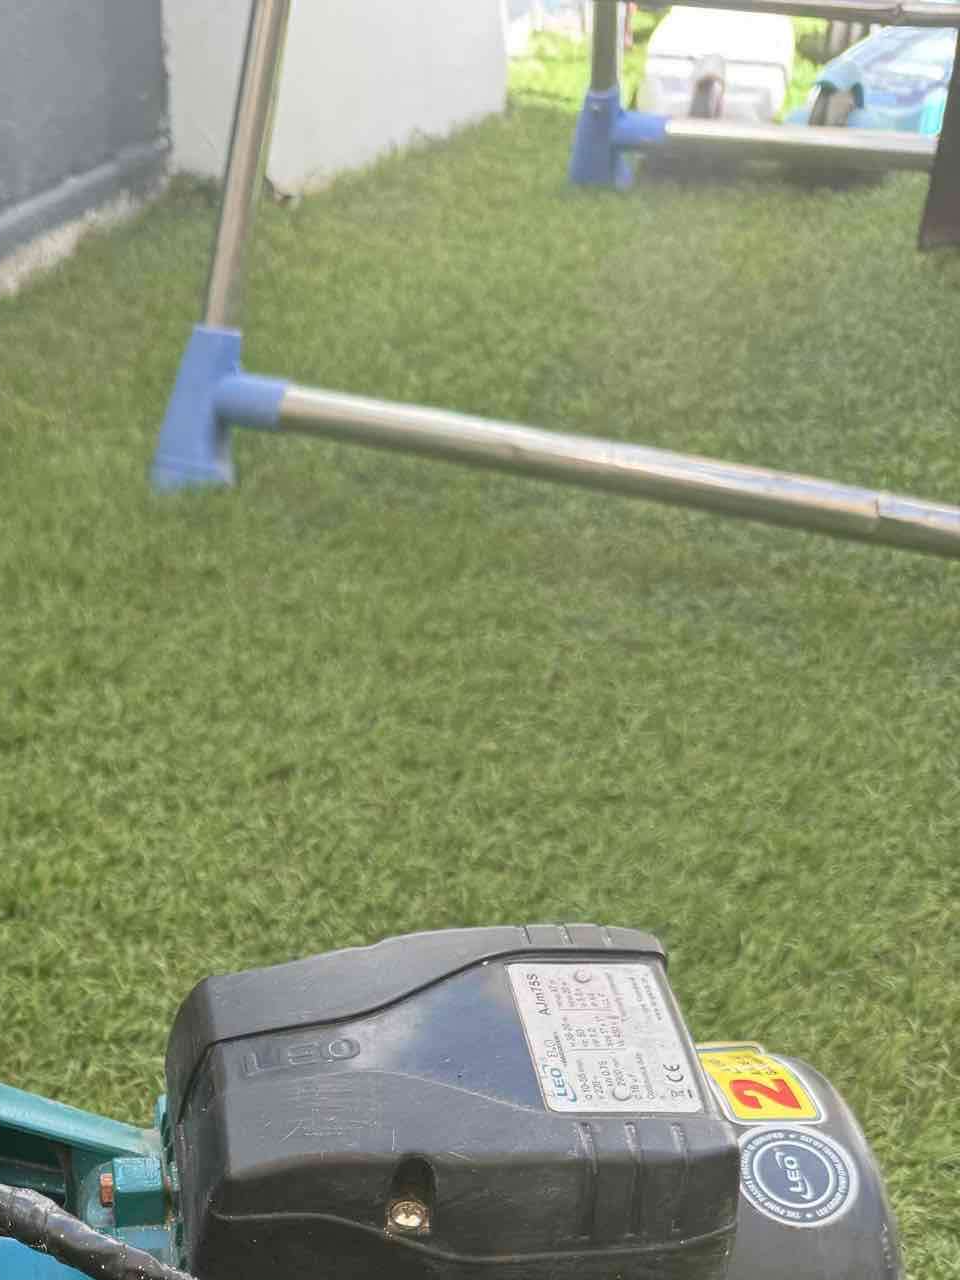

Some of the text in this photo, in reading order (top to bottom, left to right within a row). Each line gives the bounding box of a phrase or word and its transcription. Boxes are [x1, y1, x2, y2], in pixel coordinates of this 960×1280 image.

[526, 973, 551, 1015] AJm75S
[241, 1038, 361, 1078] LEO
[550, 1069, 569, 1097] LEO
[729, 1079, 801, 1109] 2
[784, 1156, 803, 1193] LEO
